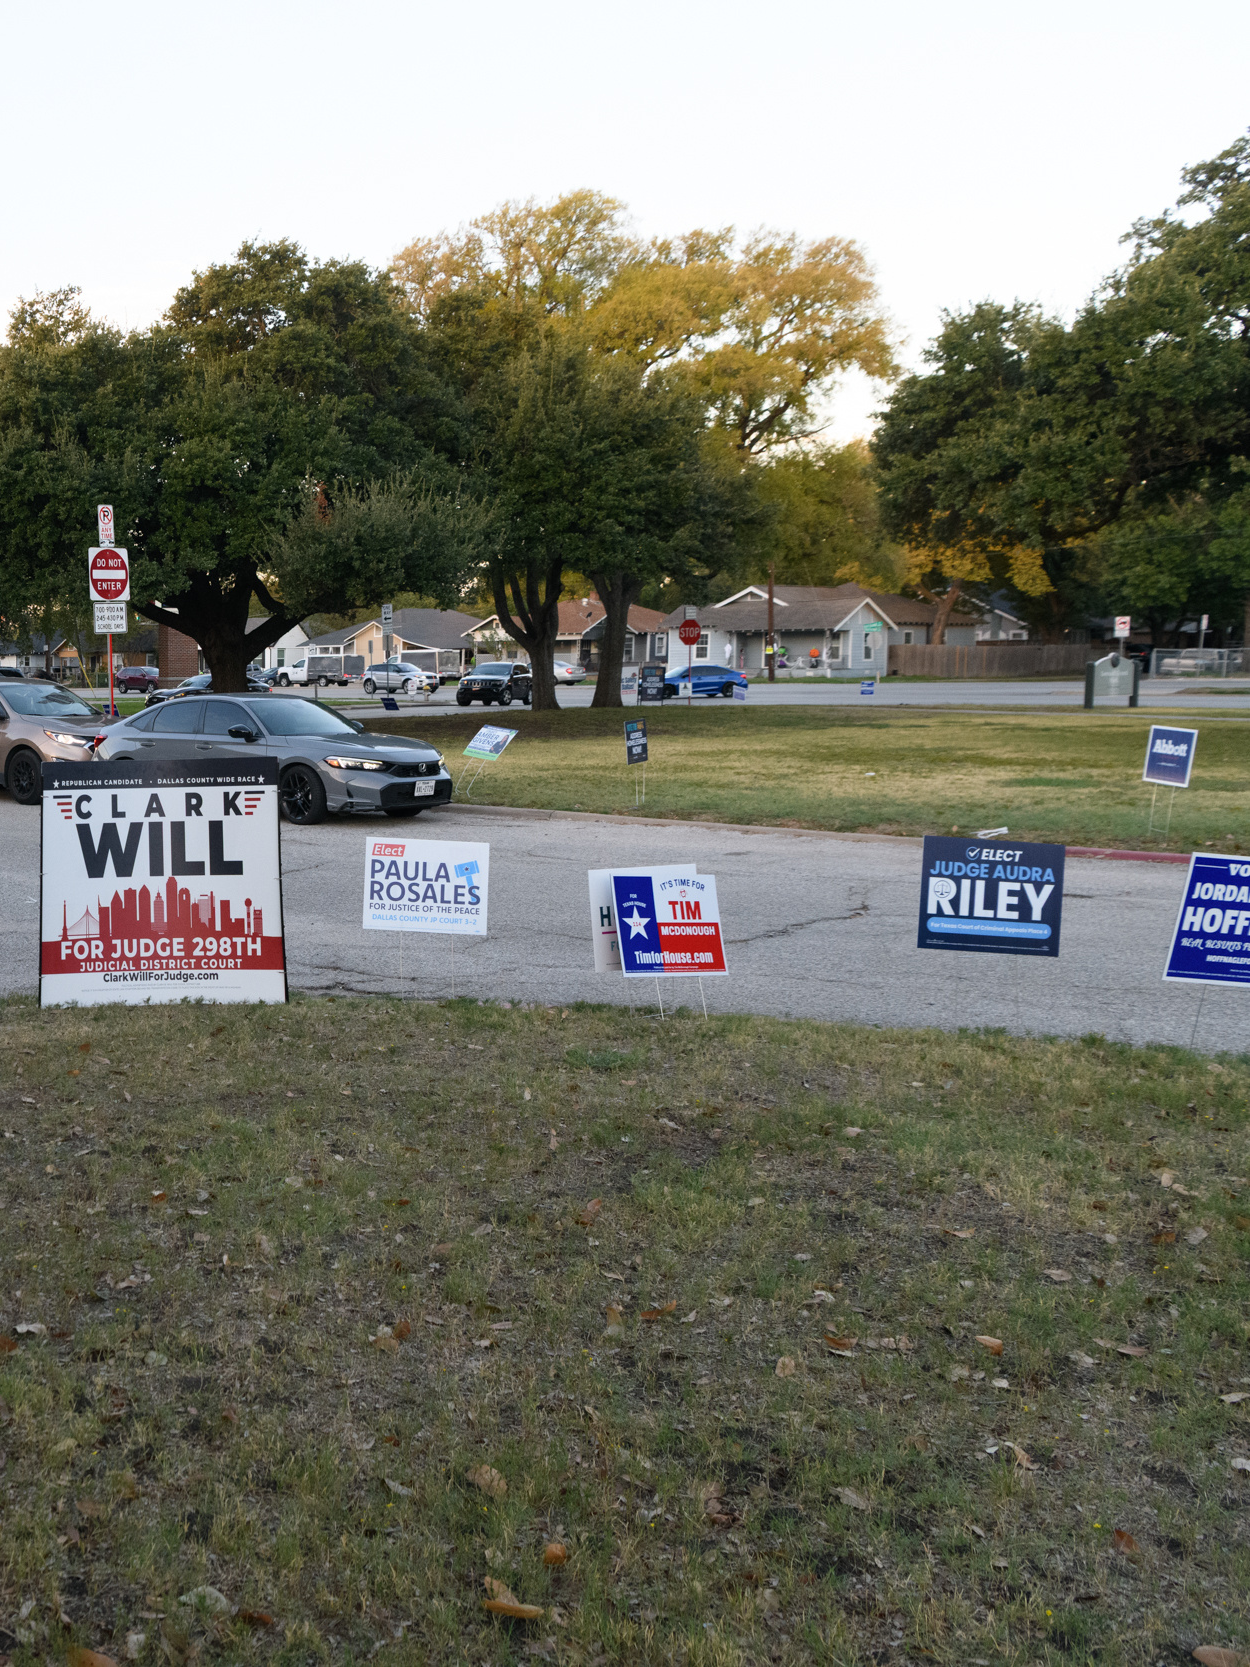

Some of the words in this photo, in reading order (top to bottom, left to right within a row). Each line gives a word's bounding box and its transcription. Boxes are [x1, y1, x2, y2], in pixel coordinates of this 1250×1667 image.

[96, 559, 106, 567] DO
[108, 559, 122, 568] NOT
[97, 582, 122, 590] ENTER
[680, 627, 700, 638] STOP
[1152, 738, 1188, 757] Abbott
[75, 791, 243, 820] CLARK
[75, 820, 243, 878] WILL
[374, 844, 403, 856] Elect
[981, 849, 1023, 862] ELECT
[371, 859, 450, 883] PAULA
[930, 860, 989, 878] JUDGE
[992, 864, 1055, 882] AUDRA
[370, 880, 481, 906] ROSALES
[660, 880, 673, 891] IT'S
[691, 880, 705, 891] FOR
[1192, 882, 1250, 903] JORDA
[927, 877, 1055, 921] RILEY
[388, 904, 420, 912] JUSTICE
[422, 905, 434, 913] OF
[437, 906, 452, 914] THE
[454, 907, 480, 915] PEACE
[668, 901, 702, 920] TIM
[1181, 906, 1250, 936] HOFF
[660, 926, 716, 936] MCDONOUGH
[61, 939, 104, 960] FOR
[111, 937, 185, 958] JUDGE
[193, 937, 262, 956] 298TH
[1181, 937, 1204, 950] REAL
[1205, 939, 1242, 952] RESULTS
[79, 960, 135, 972] JUDICIAL
[141, 959, 196, 970] DISTRICT
[201, 958, 242, 969] COURT
[634, 951, 714, 964] TimforHouse.com
[103, 970, 219, 983] ClarkWillForJudge.com
